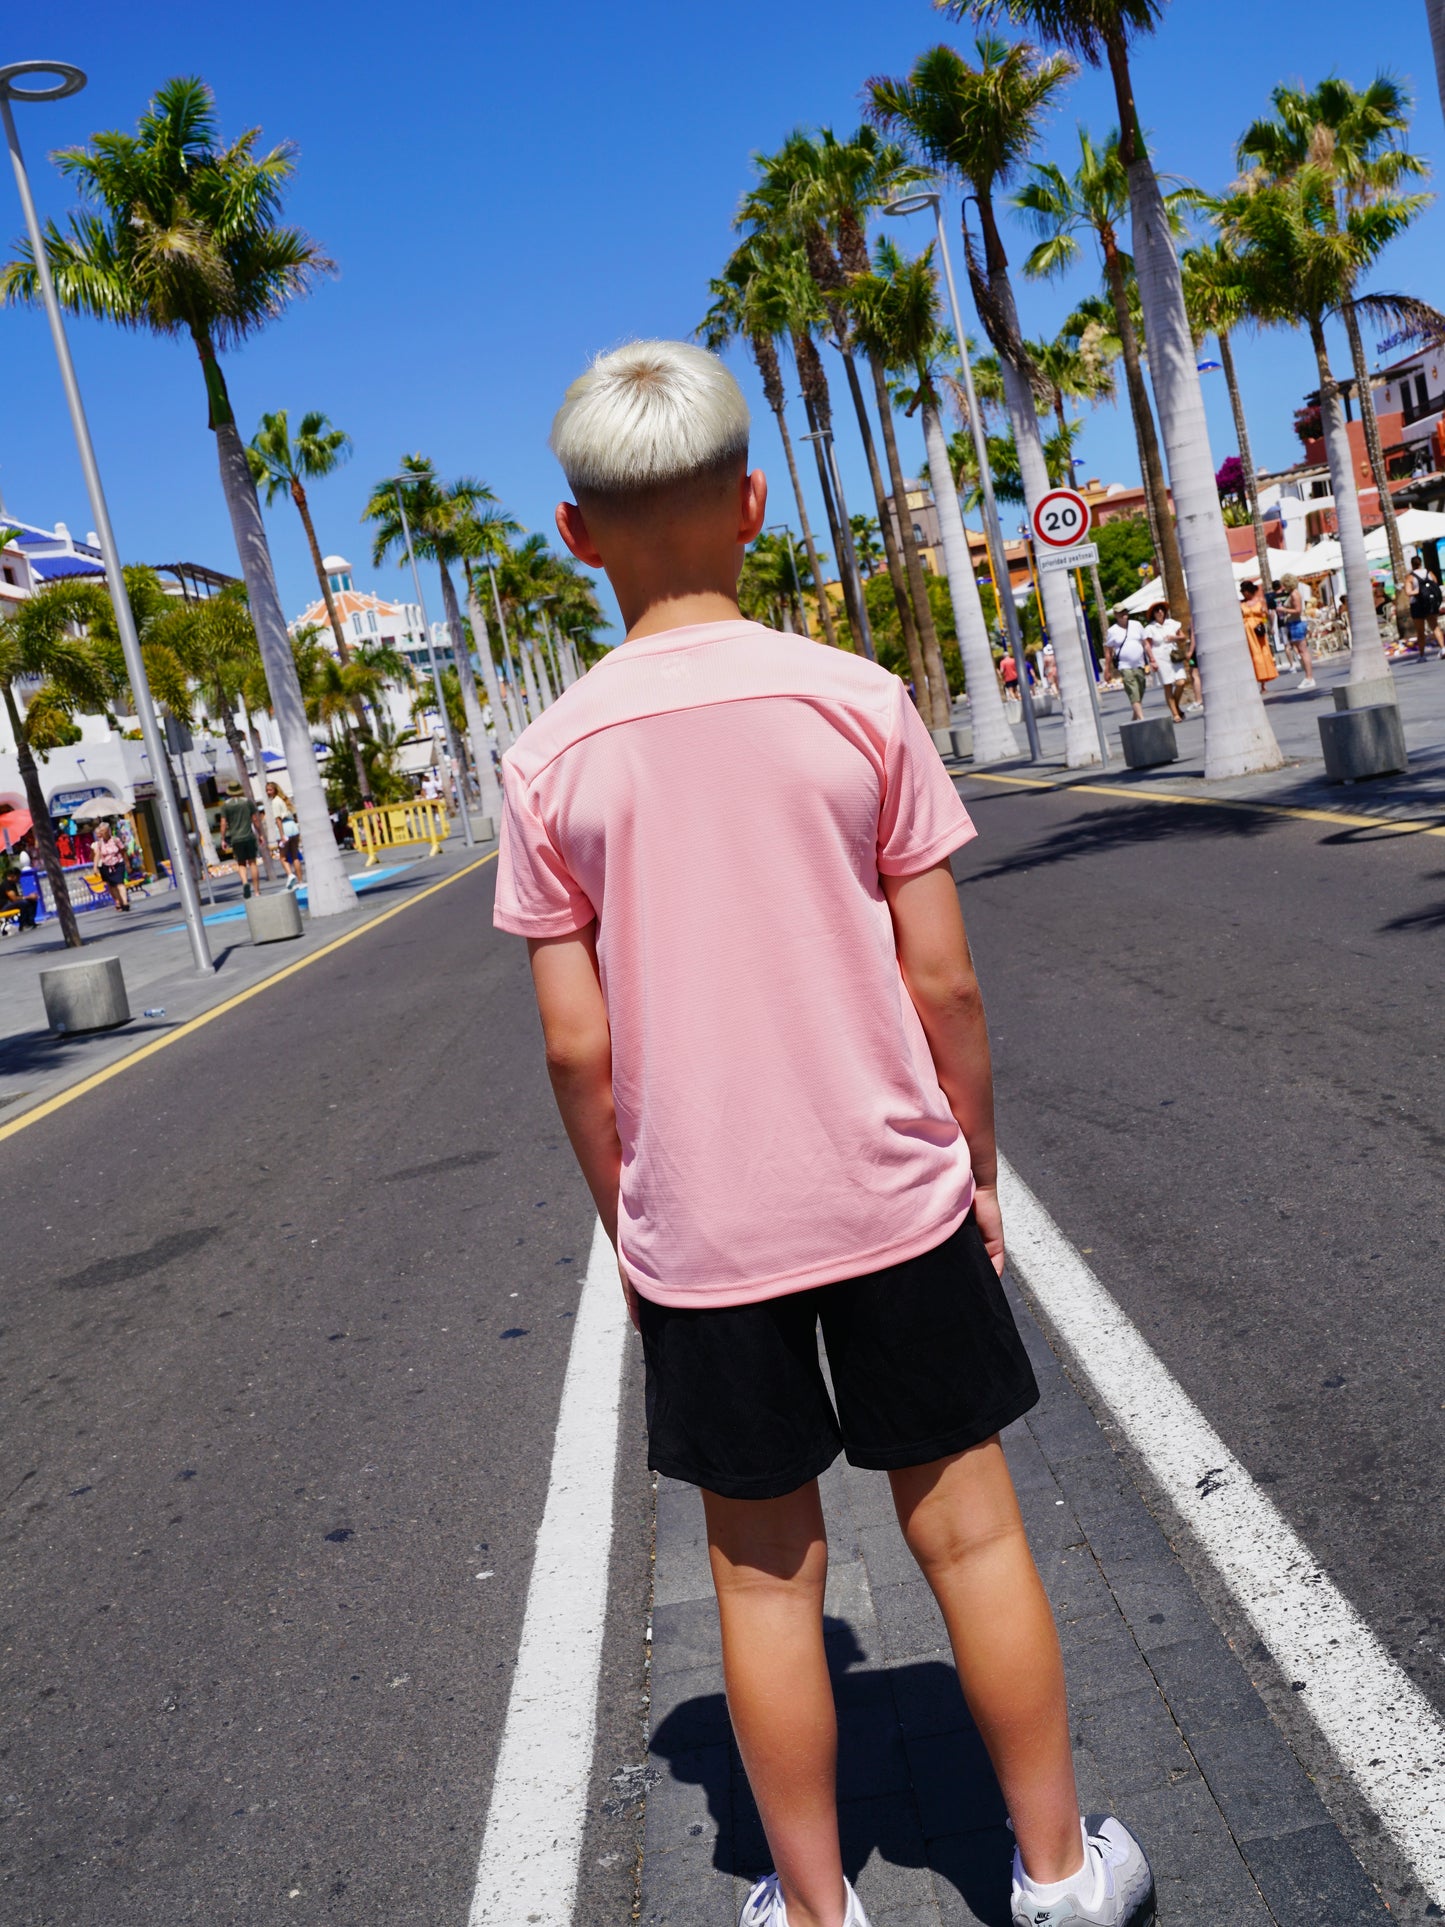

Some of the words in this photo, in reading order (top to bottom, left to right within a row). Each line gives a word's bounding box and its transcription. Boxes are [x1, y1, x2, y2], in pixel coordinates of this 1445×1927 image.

[1045, 508, 1077, 531] 20
[1042, 556, 1067, 569] prioridad
[1068, 551, 1094, 563] peatonal
